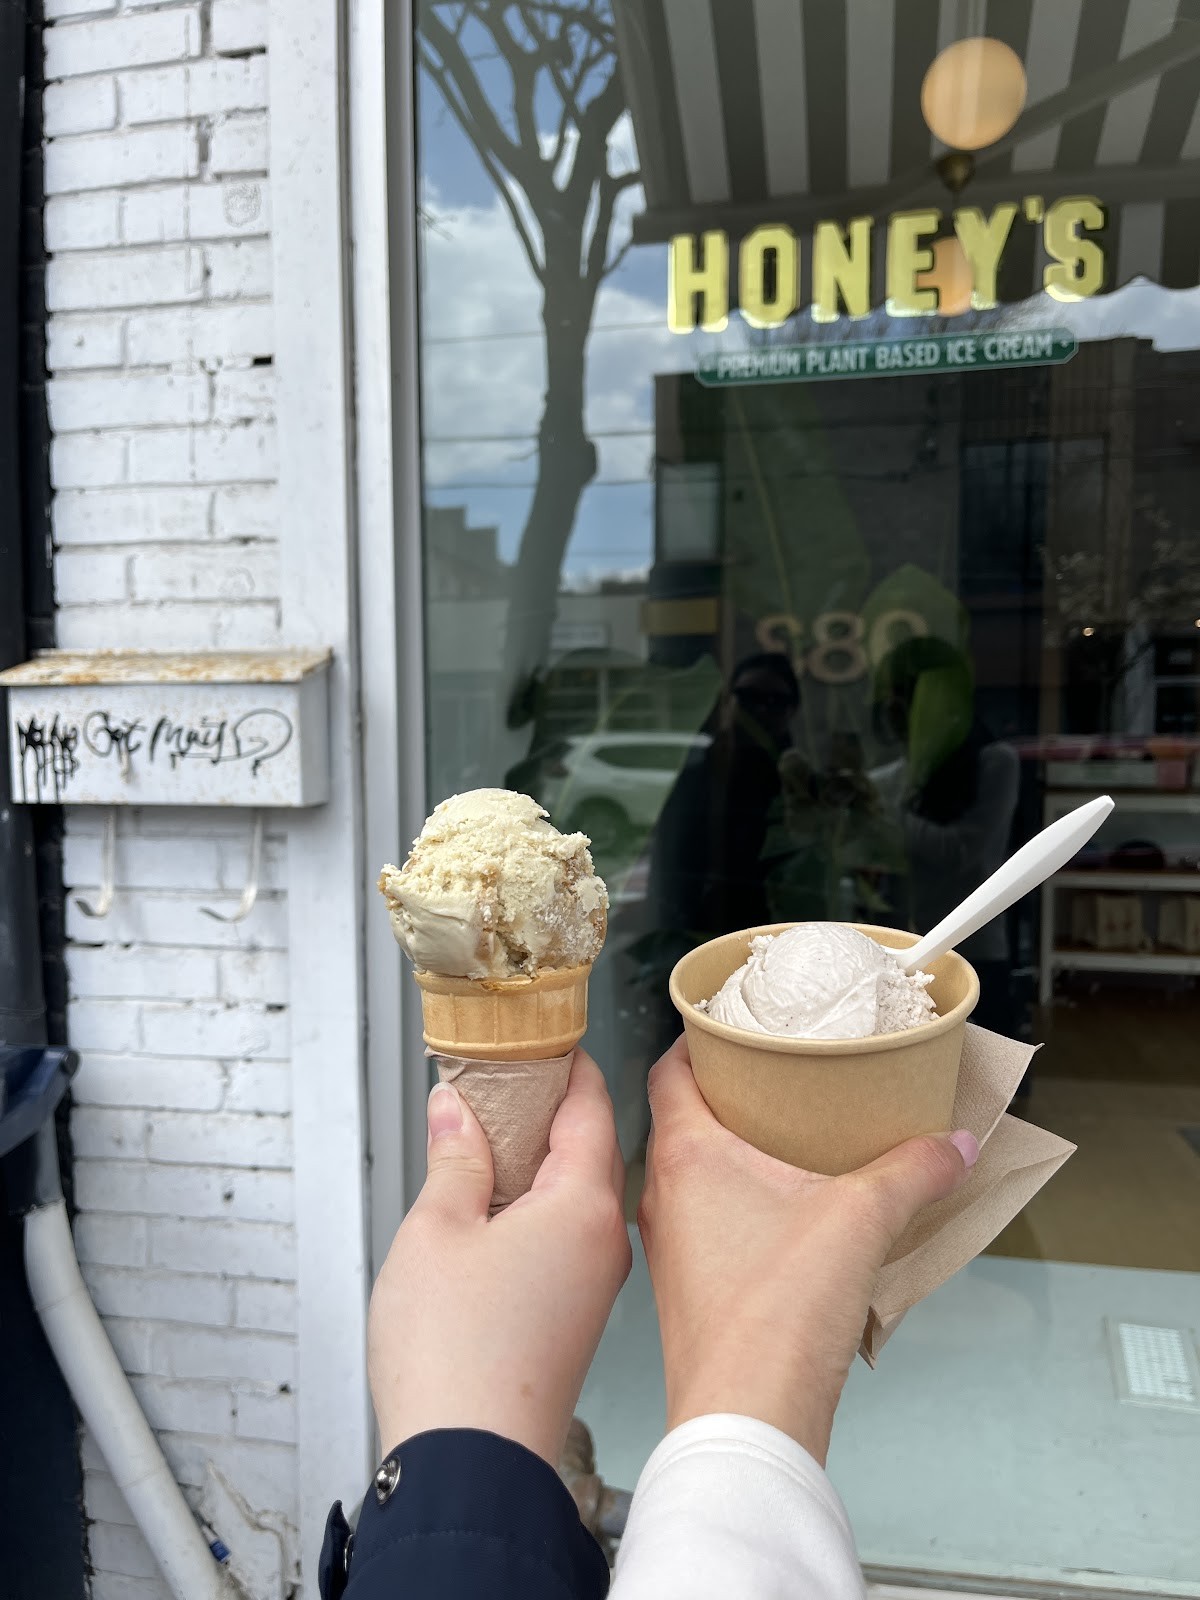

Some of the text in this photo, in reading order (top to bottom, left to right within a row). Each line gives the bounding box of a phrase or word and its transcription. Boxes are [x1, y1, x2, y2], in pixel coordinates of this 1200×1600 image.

[667, 196, 1105, 334] HONEY'S
[716, 333, 1053, 380] PREMIUM PLANT BASED ICE CREAM
